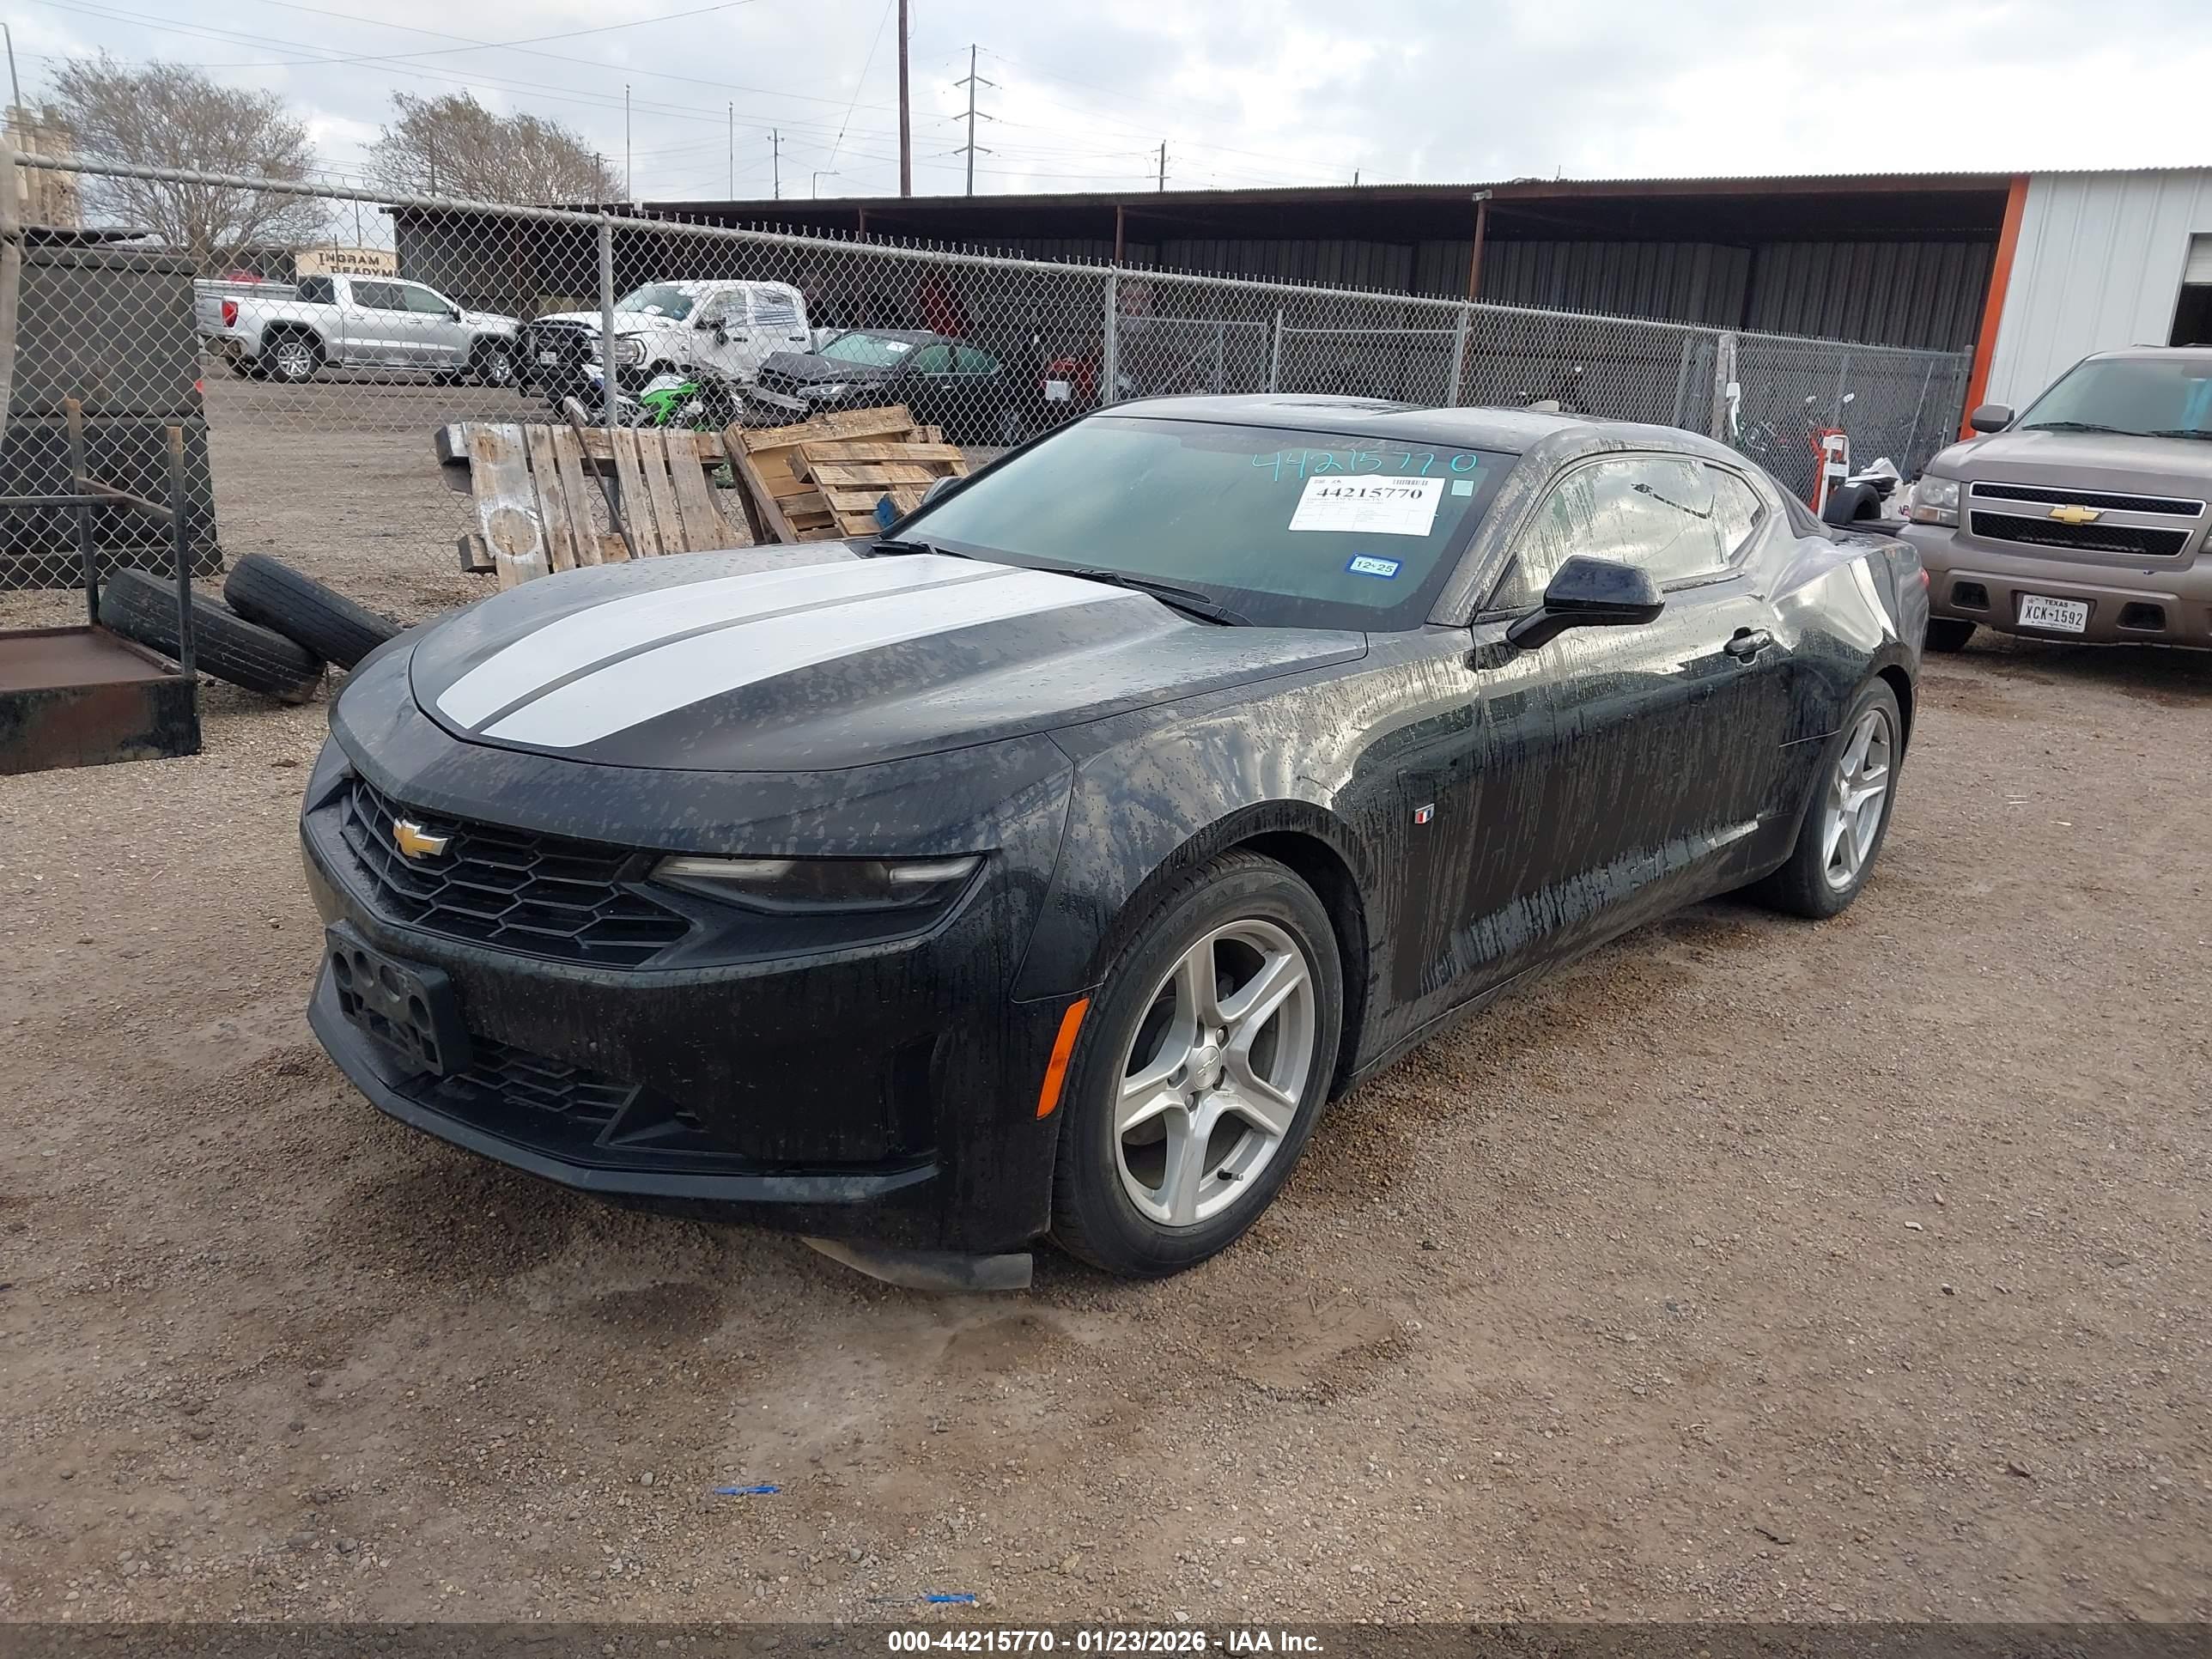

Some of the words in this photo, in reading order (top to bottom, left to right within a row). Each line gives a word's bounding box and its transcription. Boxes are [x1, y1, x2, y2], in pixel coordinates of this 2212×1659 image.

[319, 252, 380, 265] INGRAM
[1316, 487, 1423, 500] 44215770
[2045, 599, 2069, 608] TEXAS
